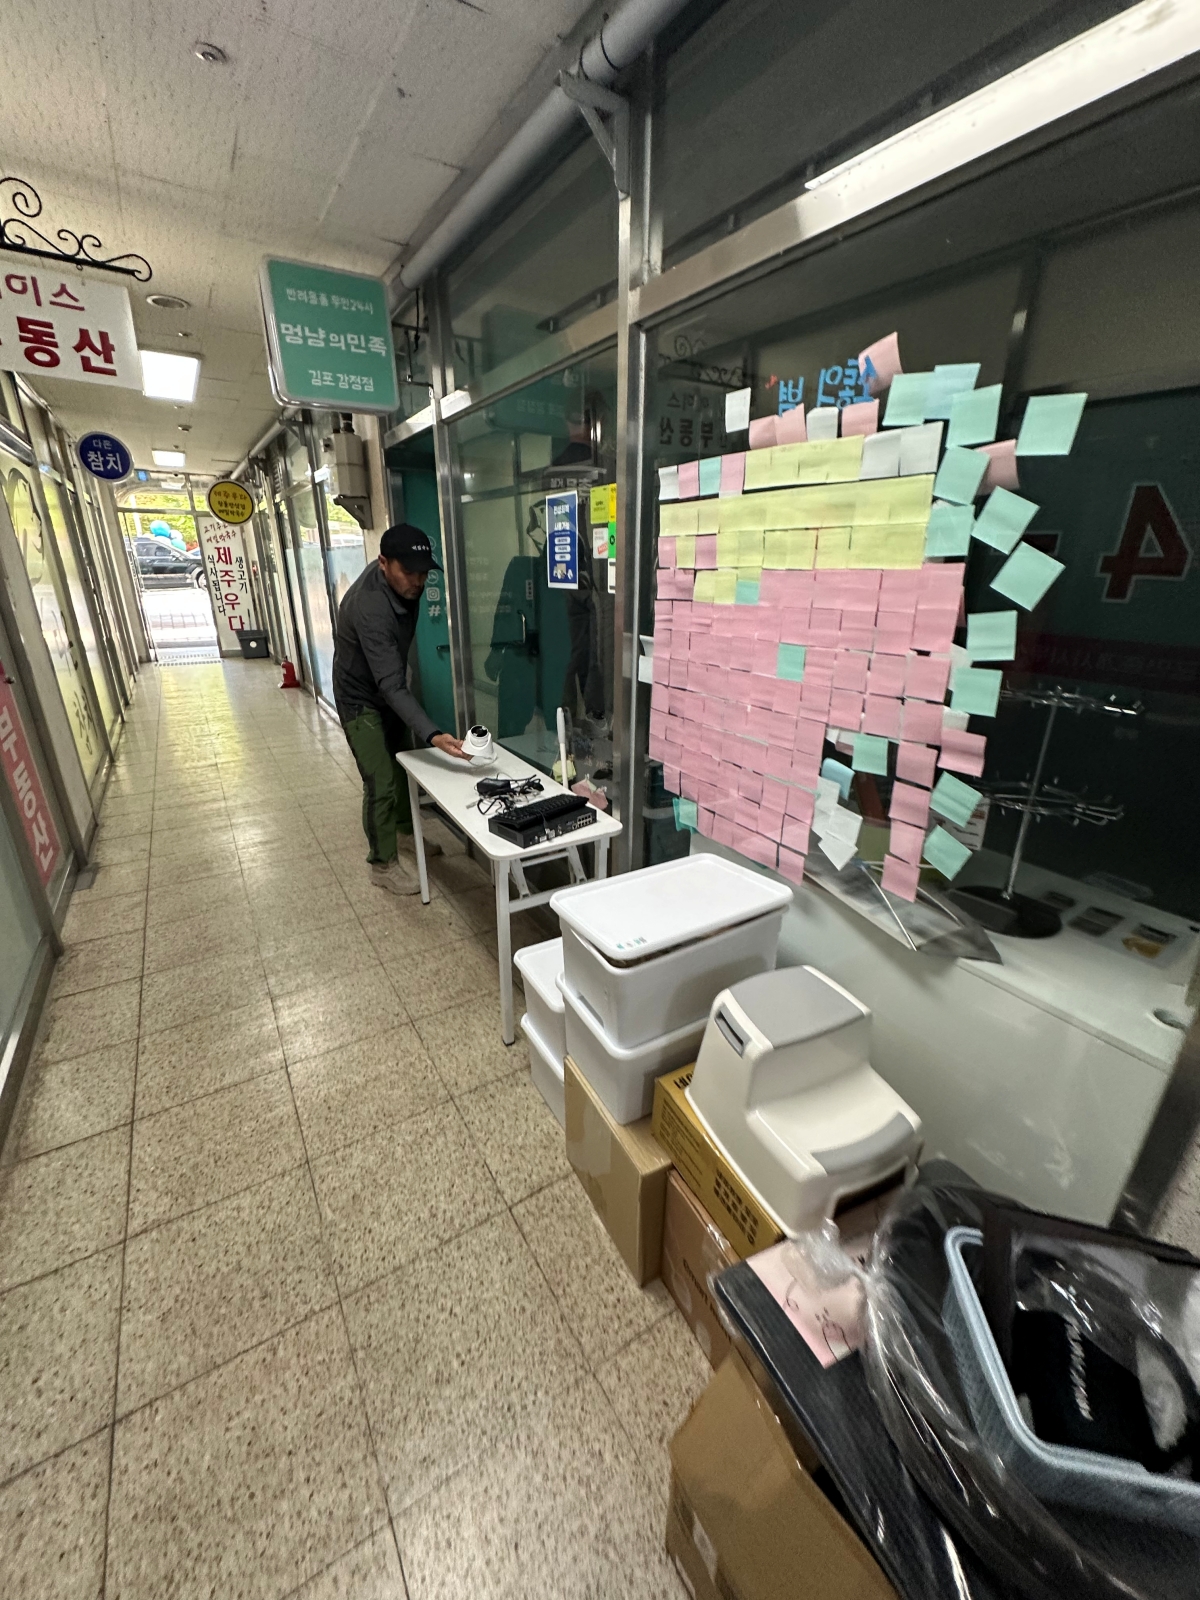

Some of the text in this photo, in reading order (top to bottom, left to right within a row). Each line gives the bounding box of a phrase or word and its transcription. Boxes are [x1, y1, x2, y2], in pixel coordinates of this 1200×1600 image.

[0, 274, 85, 311] 이스
[0, 316, 117, 377] 동산
[308, 370, 375, 392] 김포 감정점
[87, 450, 123, 473] 참치
[207, 554, 227, 617] 식사됩니다
[214, 546, 246, 632] 제주우다
[235, 556, 248, 594] 생고기
